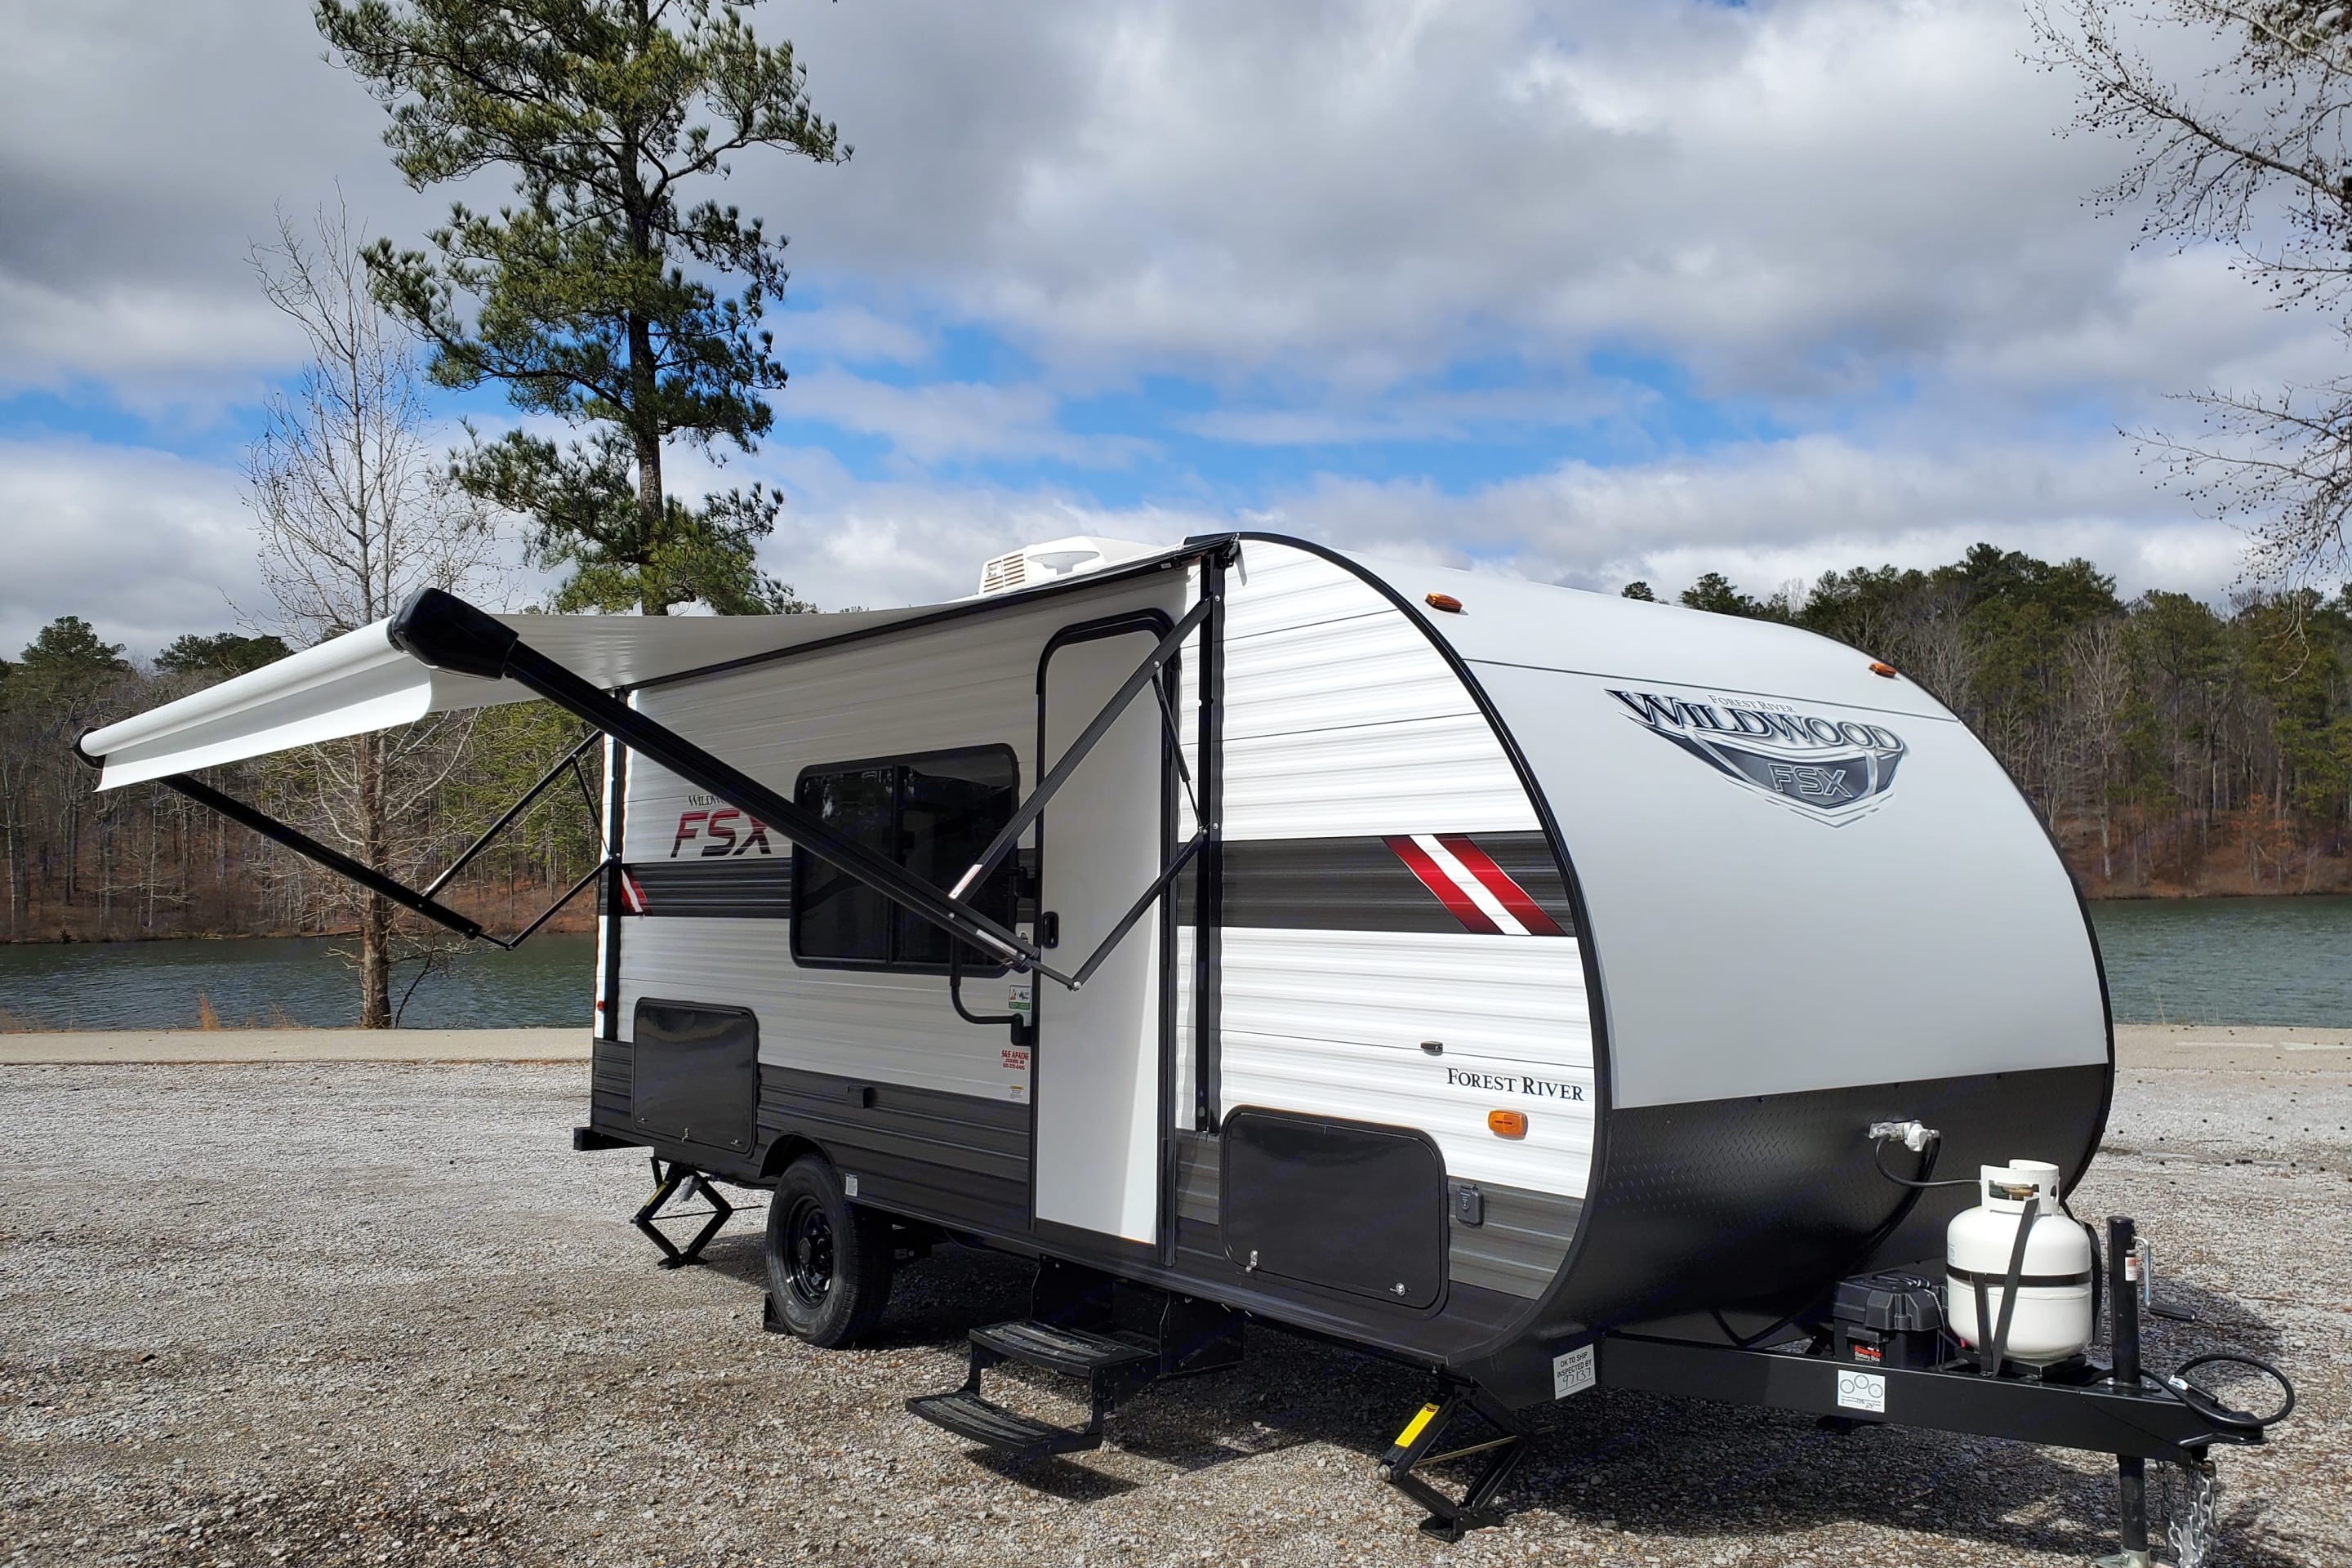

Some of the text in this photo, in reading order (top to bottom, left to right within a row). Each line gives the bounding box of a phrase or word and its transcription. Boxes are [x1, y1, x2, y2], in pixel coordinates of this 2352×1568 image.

[1708, 694, 1797, 713] FOREST RIVER
[1603, 688, 1906, 752] WILDWOOD
[1767, 763, 1854, 798] FSX
[688, 795, 726, 806] WILDW
[670, 807, 772, 858] FSX
[1446, 1067, 1584, 1102] FOREST RIVER
[1557, 1358, 1592, 1379] INSPECTED BY
[1560, 1351, 1588, 1368] OK TO SHIP
[1562, 1366, 1591, 1388] 97137
